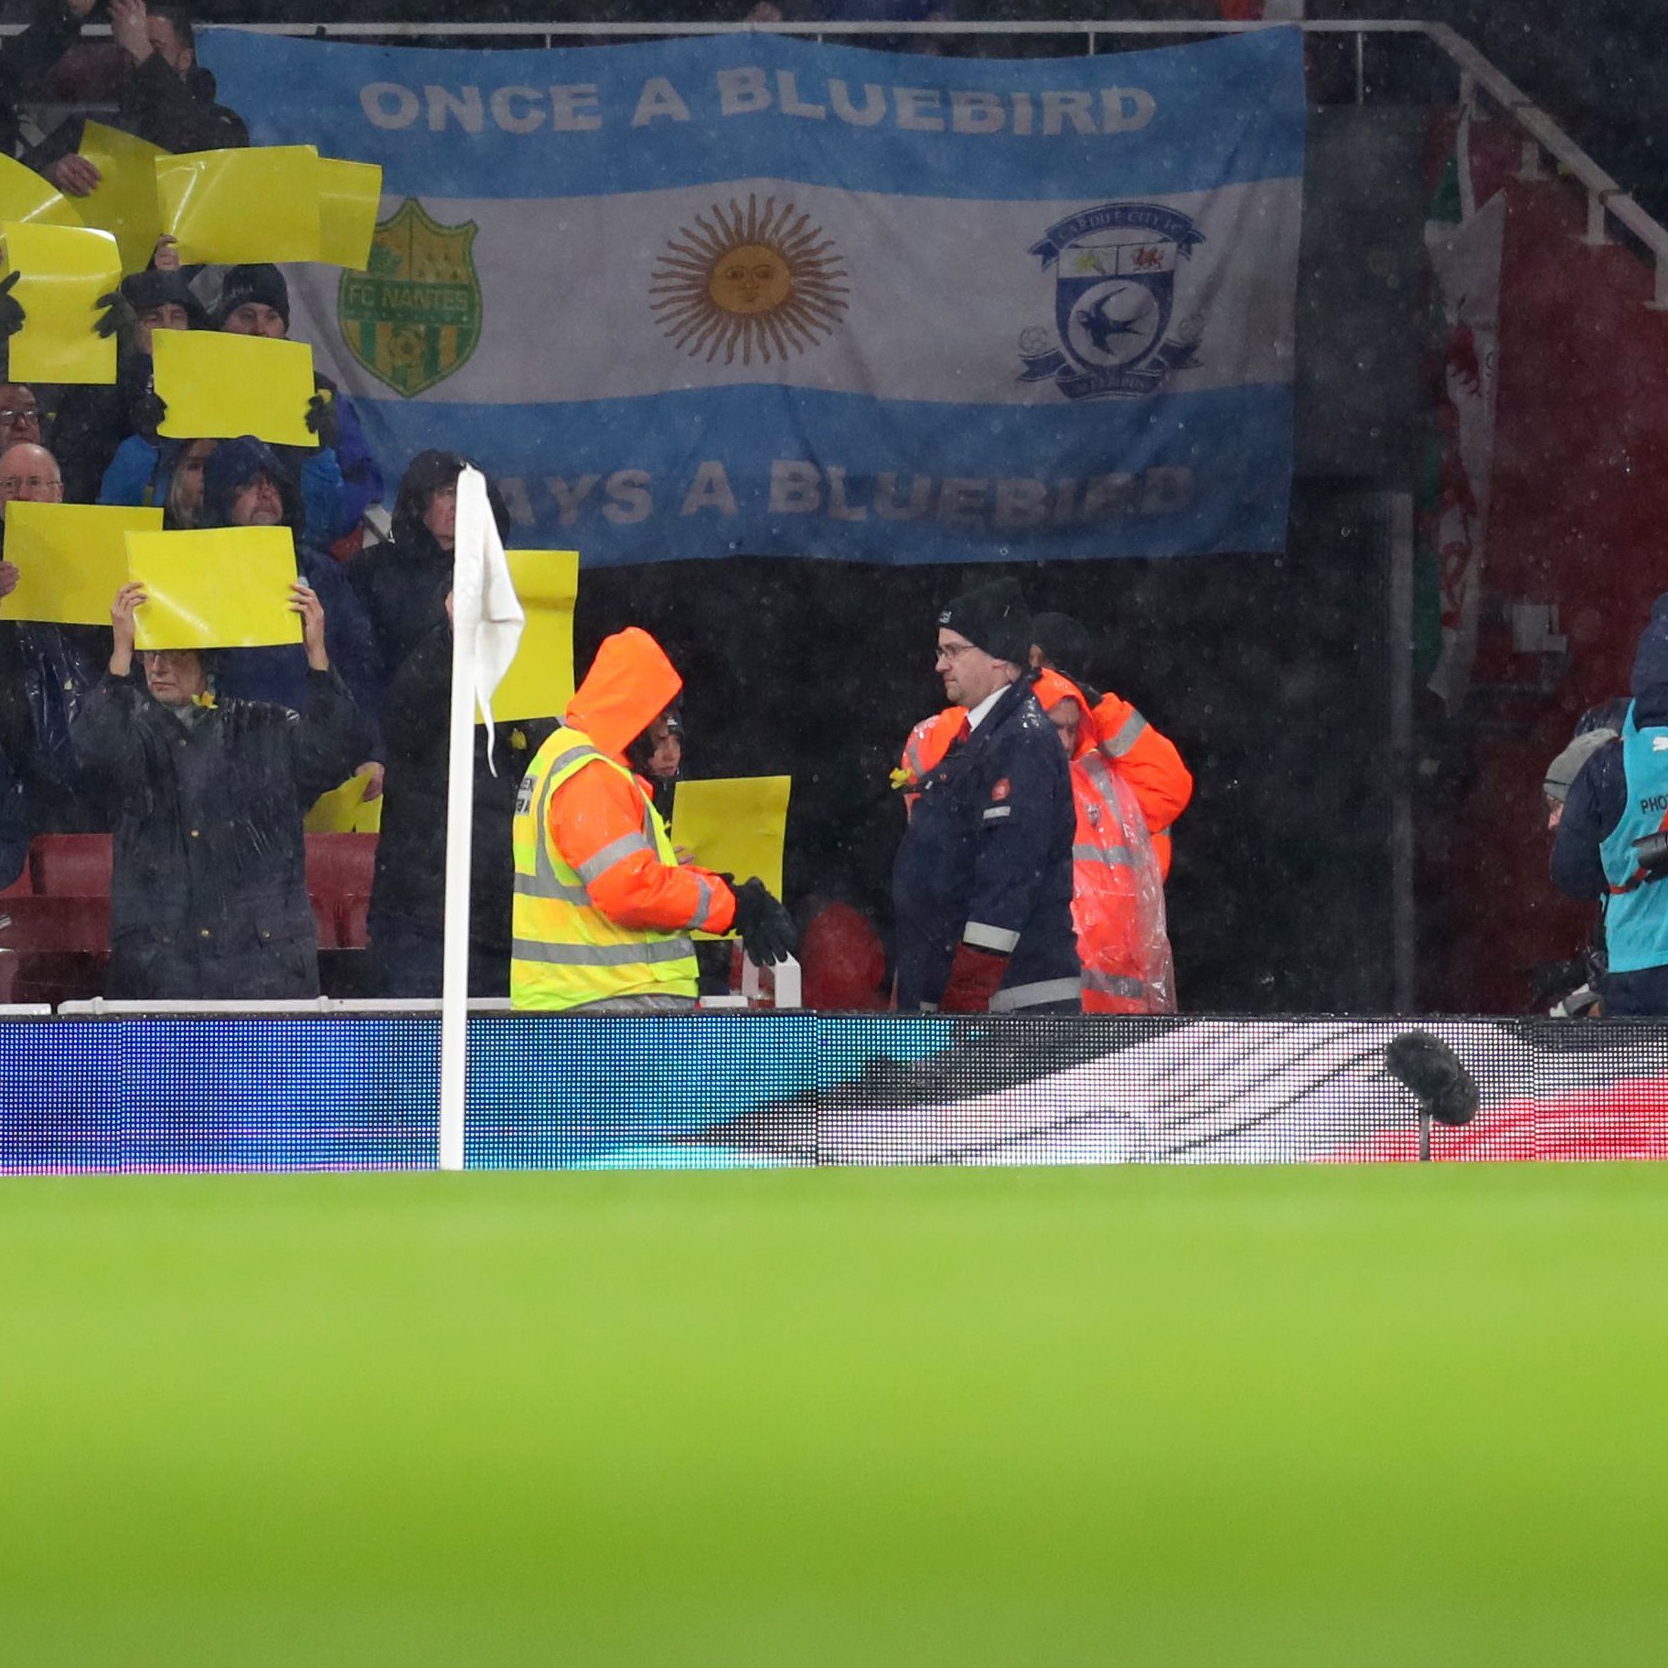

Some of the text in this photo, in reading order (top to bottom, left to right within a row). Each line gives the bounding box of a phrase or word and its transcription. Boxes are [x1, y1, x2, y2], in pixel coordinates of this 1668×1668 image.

[359, 65, 1158, 137] ONCE A BLUEBIRD
[347, 284, 469, 312] FC NANTES
[677, 459, 739, 517] A
[767, 459, 1202, 527] BLUEBIRD
